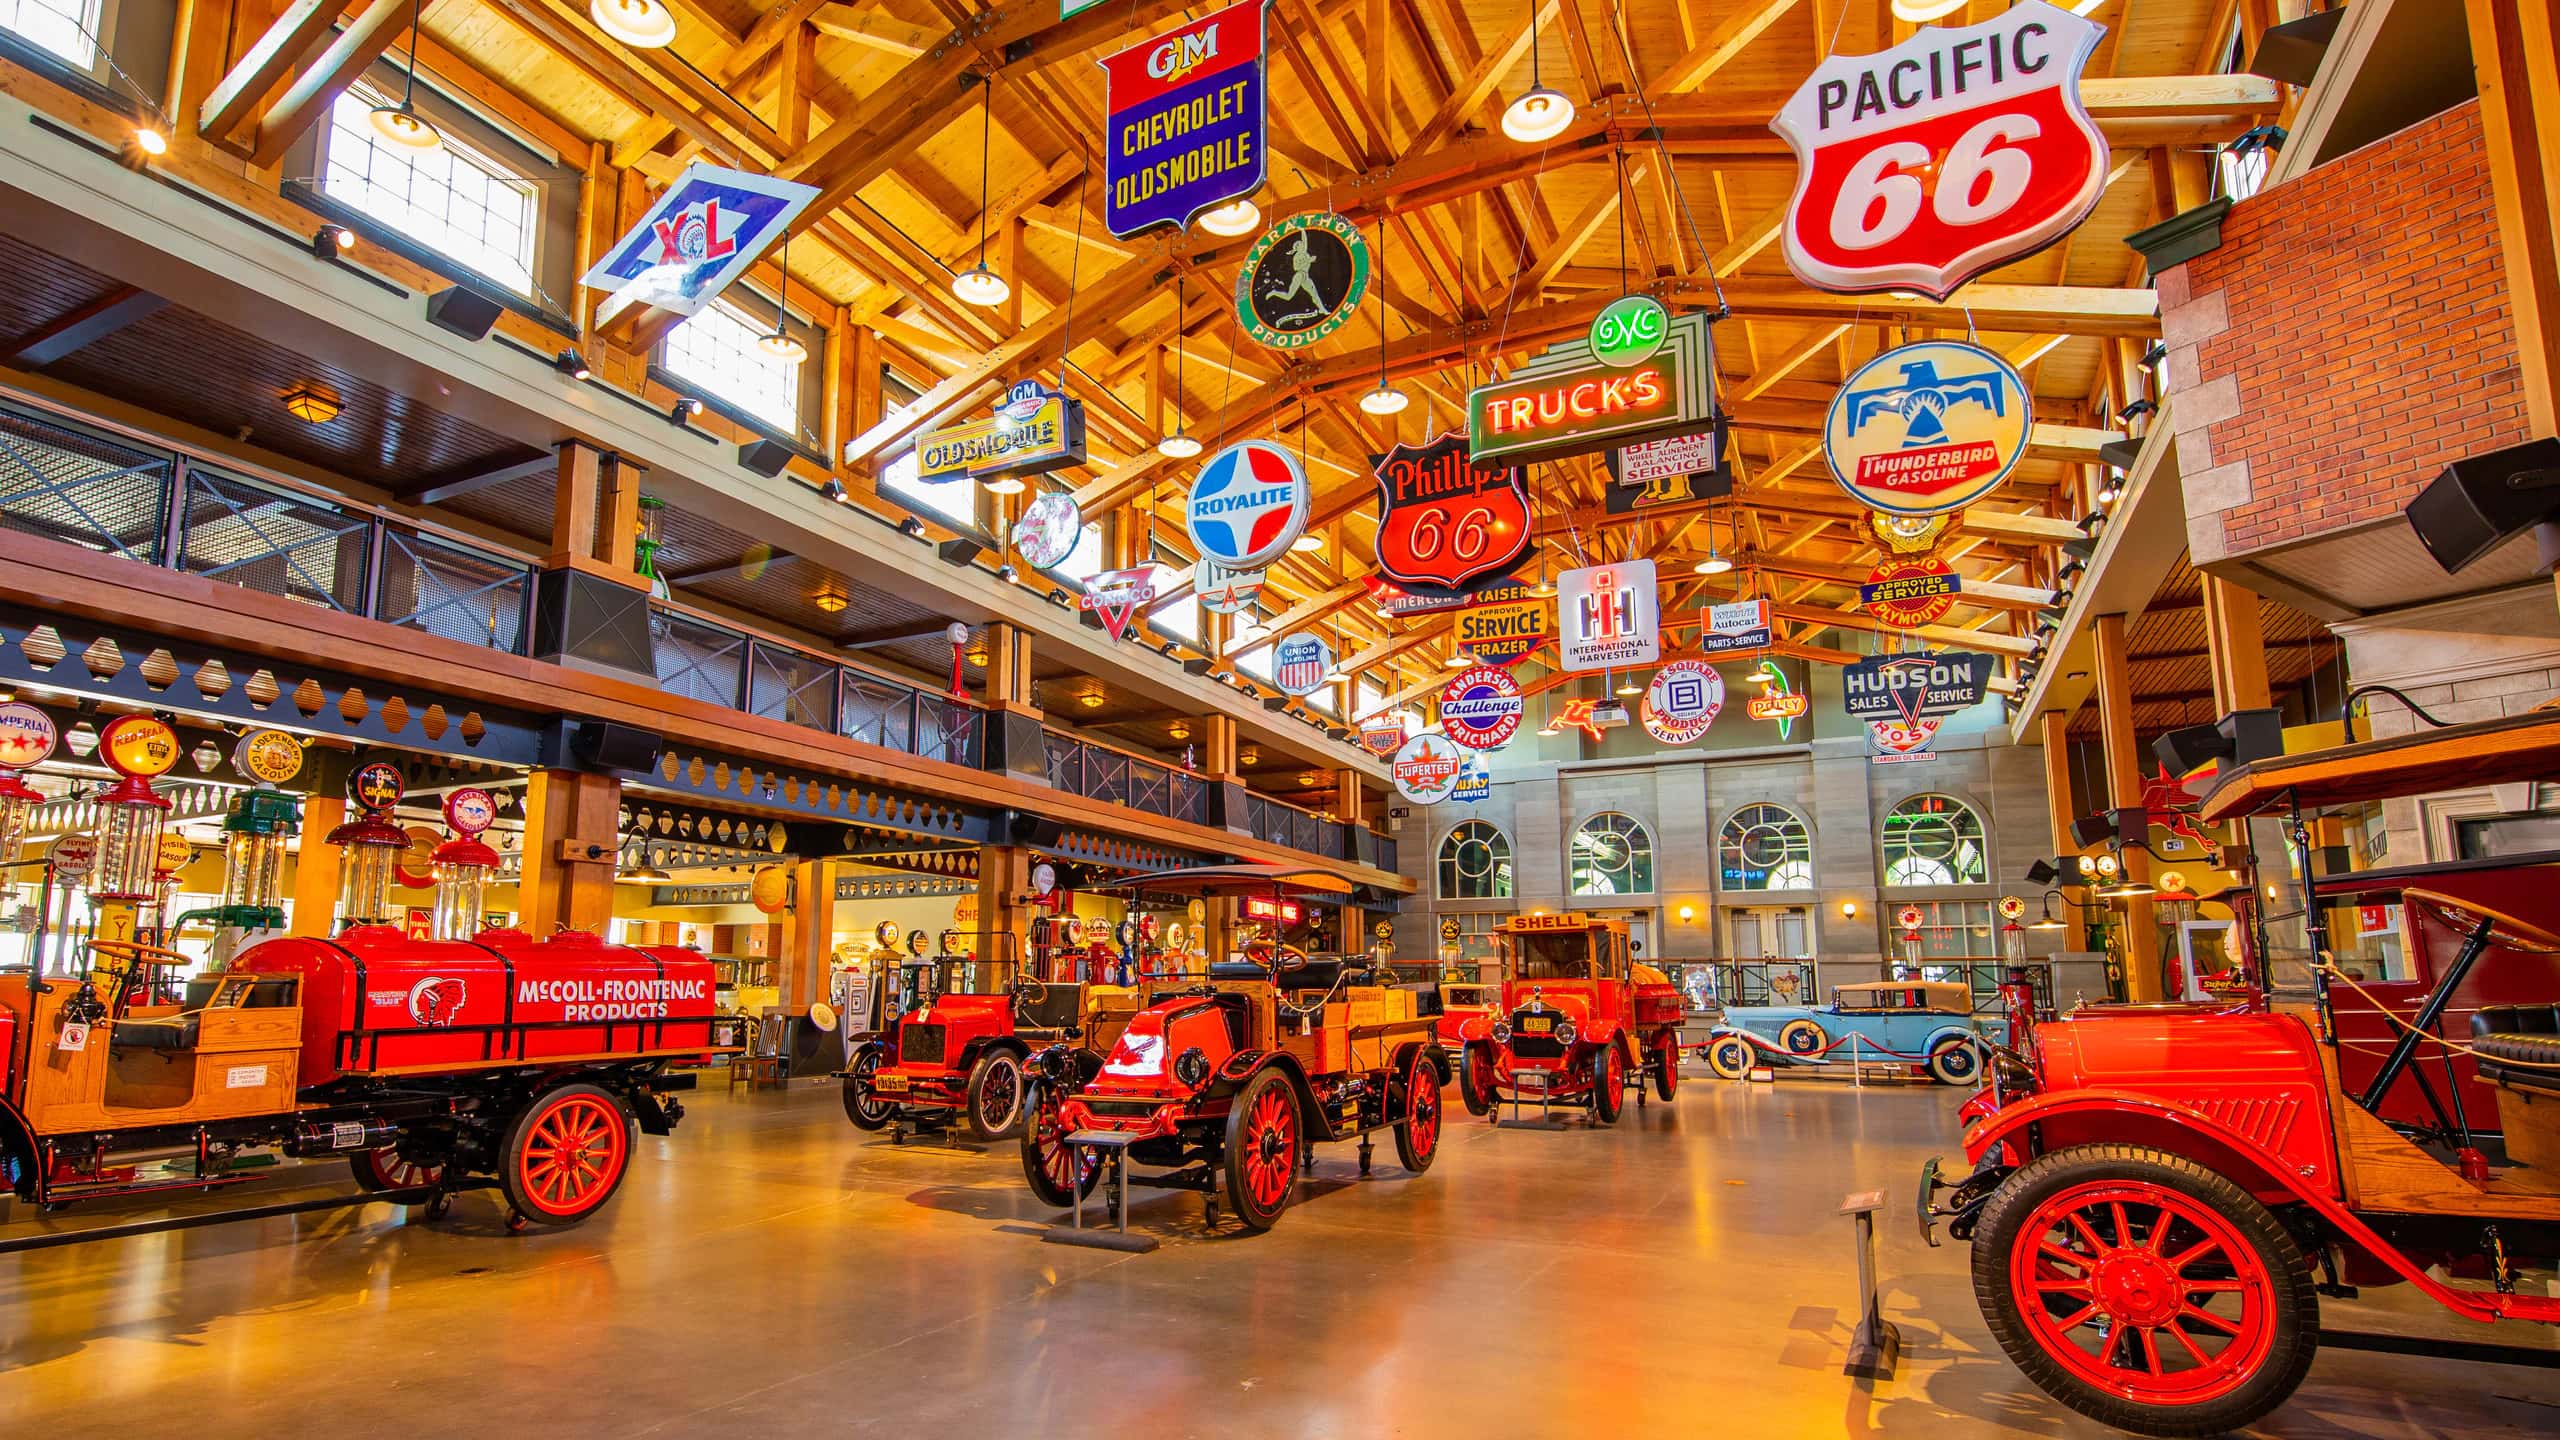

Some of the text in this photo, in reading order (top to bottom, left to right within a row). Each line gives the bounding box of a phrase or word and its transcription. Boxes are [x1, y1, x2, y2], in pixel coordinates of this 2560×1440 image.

[1147, 23, 1220, 79] GM
[1817, 23, 2050, 130] PACIFIC
[1123, 80, 1248, 157] CHEVROLET
[1116, 132, 1251, 209] OLDSMOBILE
[1829, 113, 2041, 250] 66
[1246, 214, 1361, 273] MARATHON
[1251, 301, 1356, 347] PRODUCTS
[1012, 382, 1037, 402] GM
[1487, 371, 1659, 433] TRUCKS
[924, 420, 1054, 469] OLDSMOBILE
[1657, 443, 1705, 457] ALINEMENT
[1627, 457, 1708, 479] SERVICE
[1633, 451, 1698, 468] BALANCING
[1862, 446, 1995, 478] THUNDERBIRD
[1886, 465, 1968, 486] GASOLINE
[1195, 486, 1292, 516] ROYALITE
[1409, 508, 1496, 562] 66
[1476, 586, 1529, 603] KAISER
[1871, 583, 1950, 601] SERVICE
[1877, 577, 1942, 591] APPROVED
[1478, 606, 1523, 617] APPROVED
[1875, 597, 1948, 624] PLYMOUTH
[1462, 609, 1541, 639] SERVICE
[1714, 618, 1757, 629] Autocar
[1285, 646, 1316, 656] UNION
[1472, 640, 1529, 656] FRAZER
[1569, 639, 1650, 656] INTERNATIONAL
[1579, 649, 1639, 663] HARVESTER
[1449, 670, 1517, 700] ANDERSON
[1653, 662, 1718, 688] BE SQUARE
[1847, 663, 1972, 694] HUDSON
[1443, 699, 1520, 716] Challenge
[1753, 698, 1800, 712] POLLY
[1850, 688, 1974, 710] SALES SERVICE
[1655, 702, 1720, 729] PRODUCTS
[1448, 715, 1516, 746] PRICHARD
[251, 755, 299, 779] GASOLINE
[1397, 759, 1456, 777] SUPERTEST
[365, 786, 397, 799] SIGNAL
[1453, 788, 1488, 799] SERVICE
[1514, 917, 1580, 929] SHELL
[564, 1002, 668, 1022] PRODUCTS
